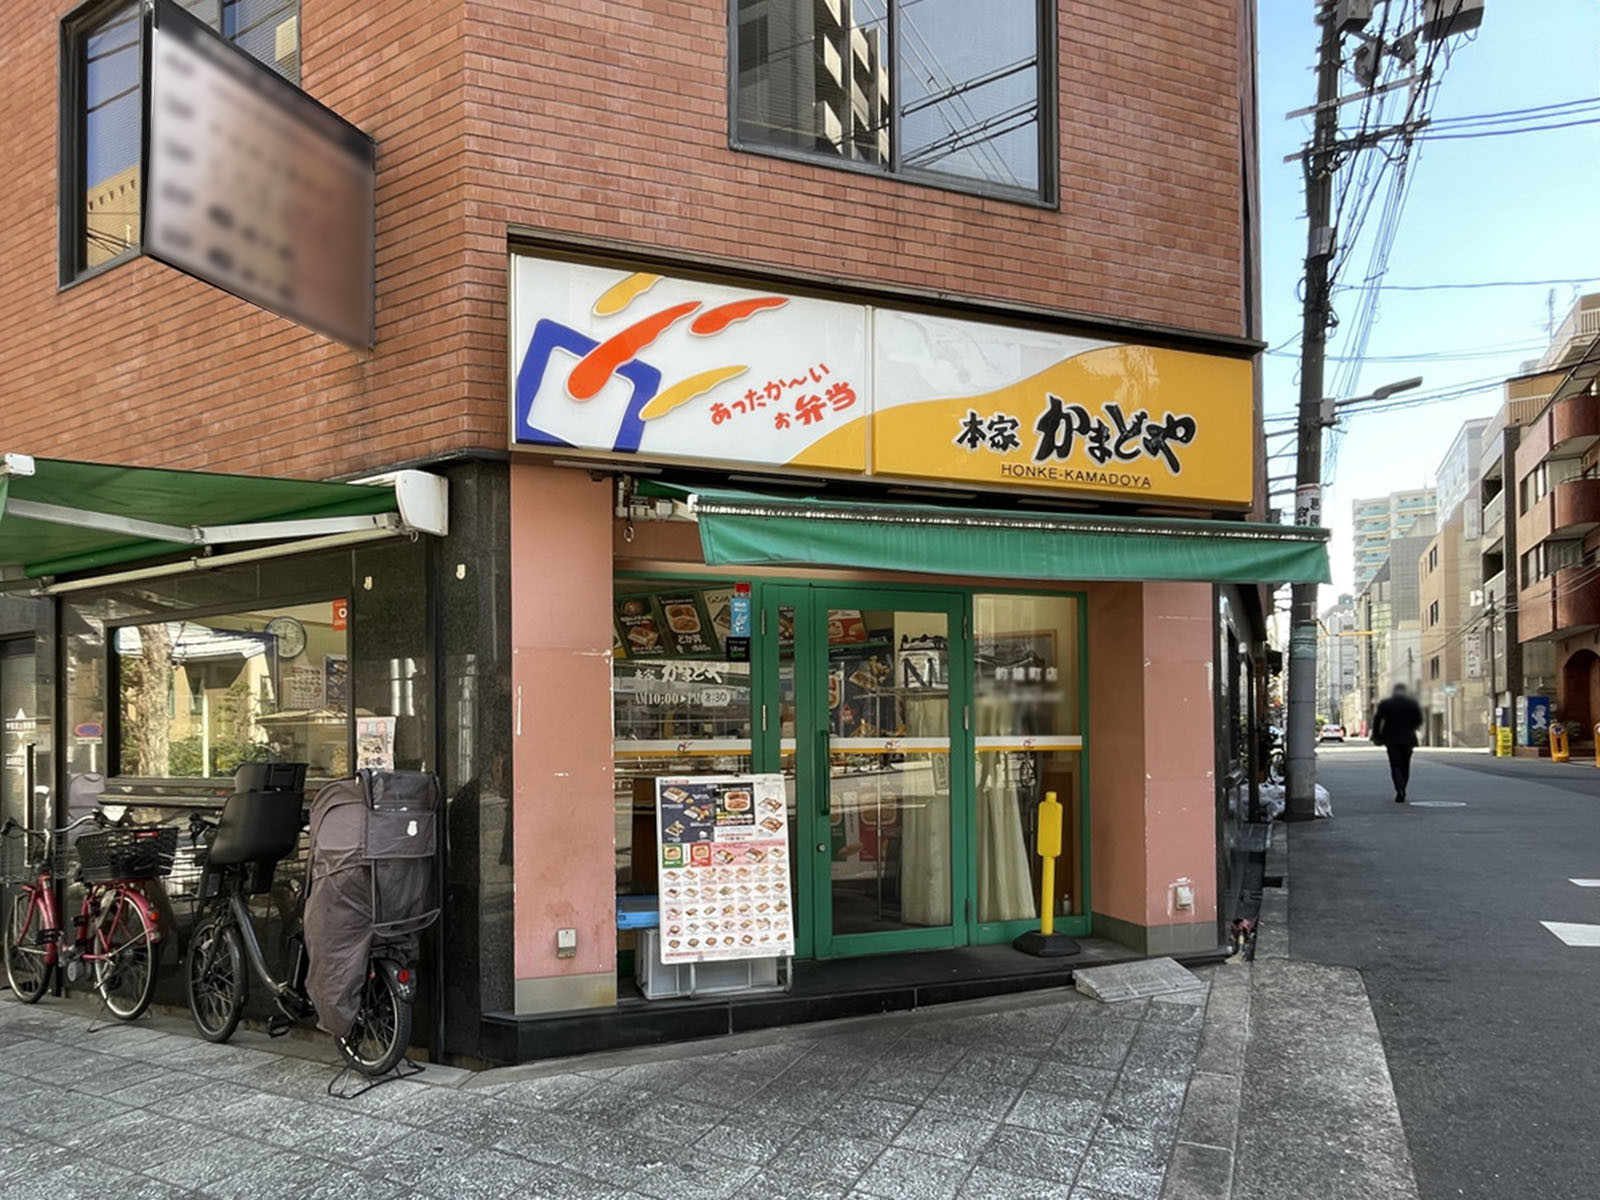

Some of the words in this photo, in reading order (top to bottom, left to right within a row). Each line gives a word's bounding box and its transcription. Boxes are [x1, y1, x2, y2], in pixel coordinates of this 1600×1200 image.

[774, 382, 857, 430] お弁当
[955, 412, 1020, 450] 本家
[1035, 394, 1197, 473] かまどや
[1001, 465, 1151, 488] HONKE-KAMADOYA
[662, 663, 730, 684] かまどや
